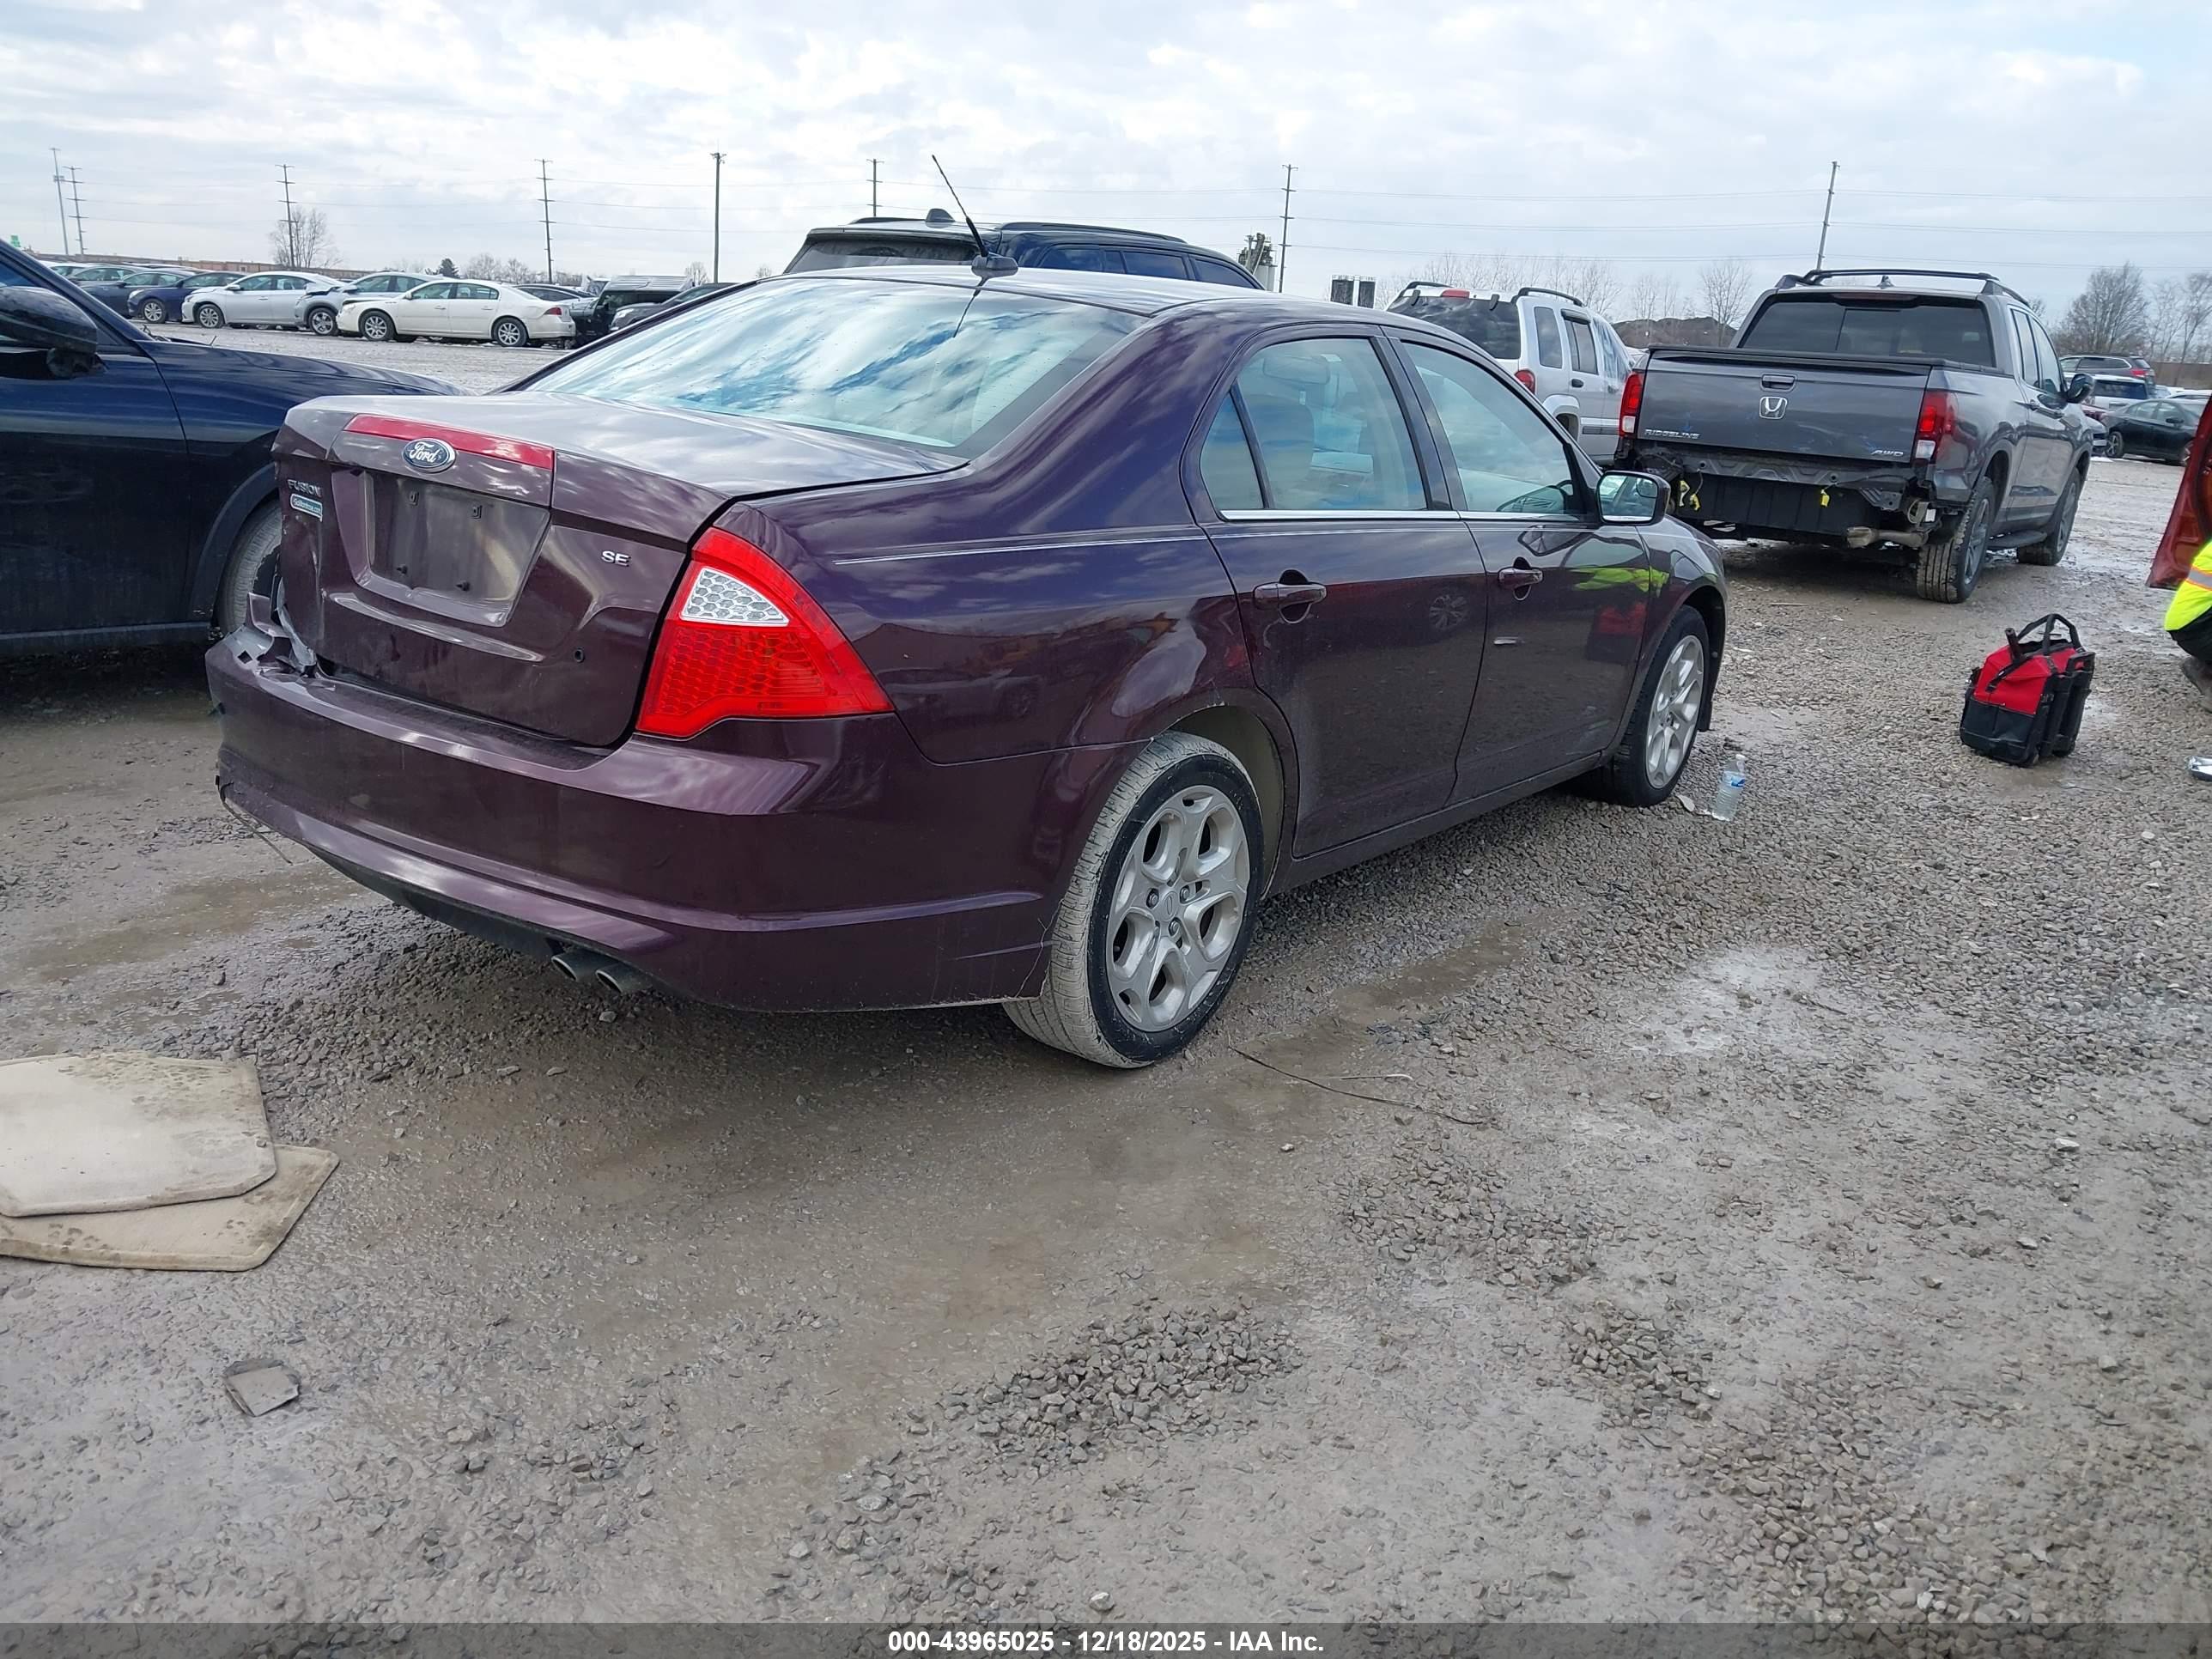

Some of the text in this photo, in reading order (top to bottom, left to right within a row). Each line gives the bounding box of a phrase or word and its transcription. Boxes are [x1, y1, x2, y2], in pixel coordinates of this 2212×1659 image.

[1644, 428, 1700, 440] RIDGELINE
[408, 441, 443, 463] Ford
[288, 478, 322, 498] FUSION
[601, 550, 630, 567] SE
